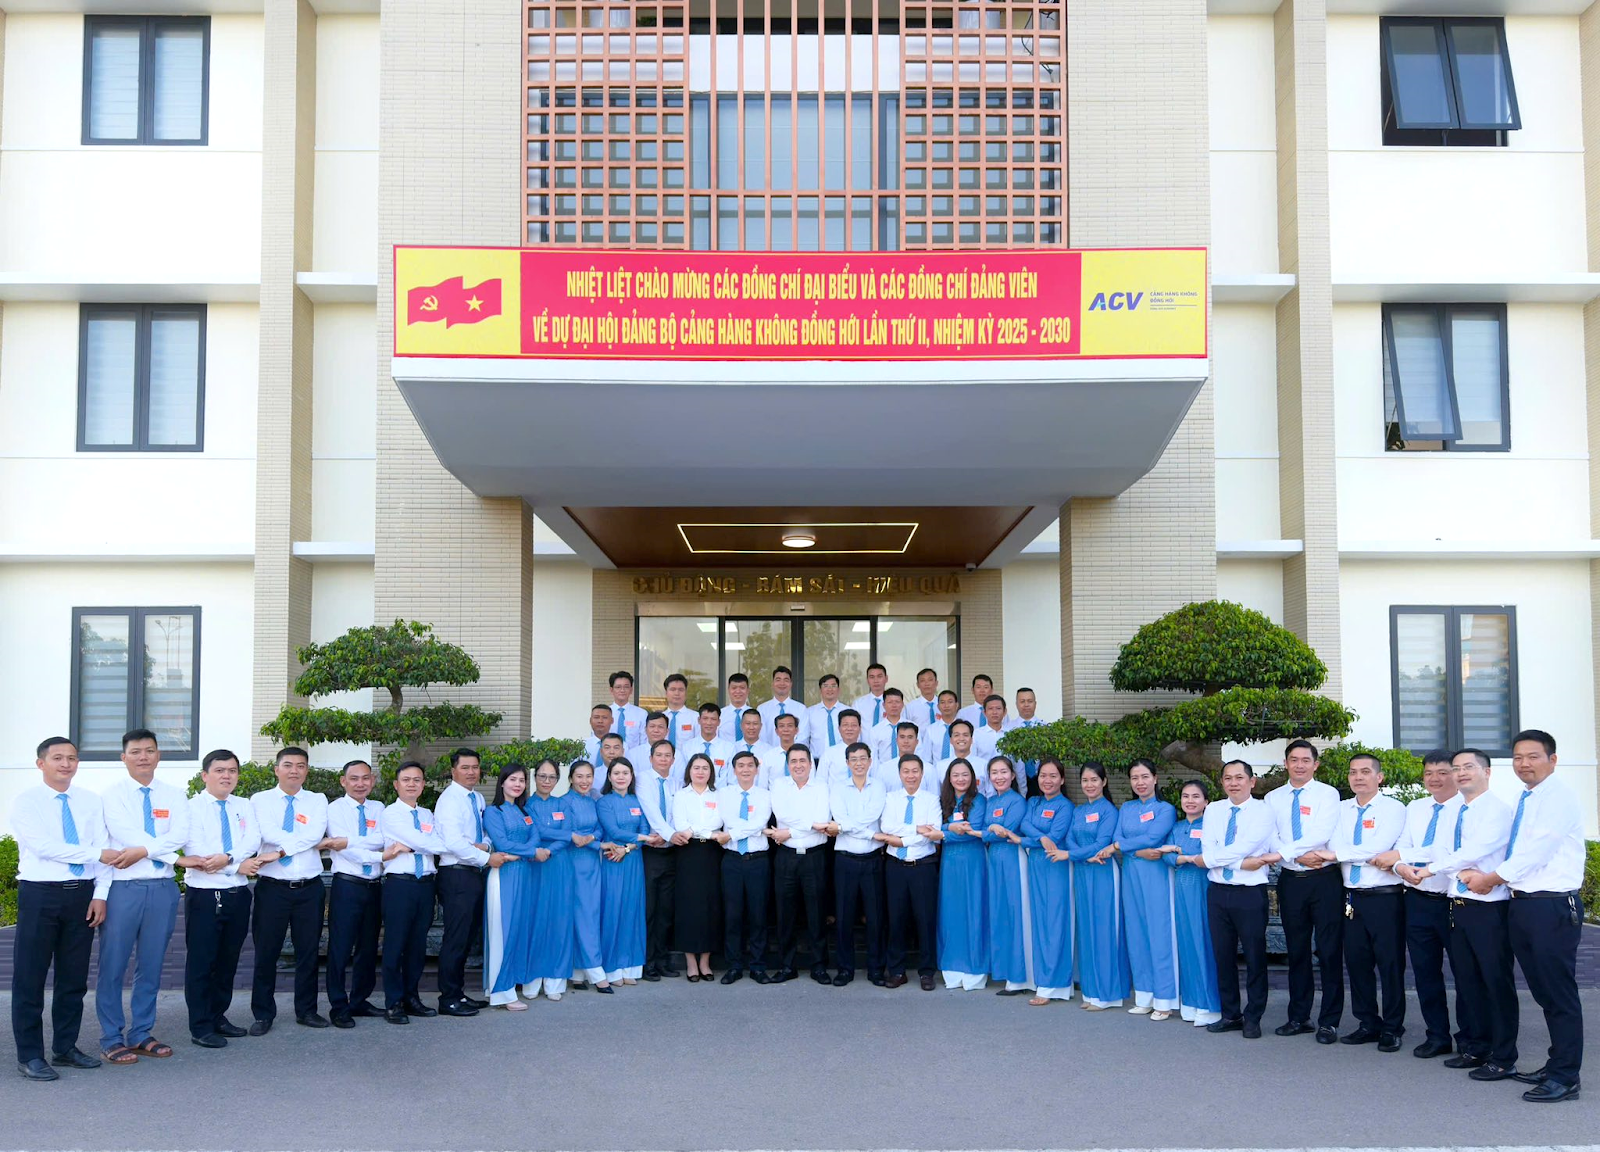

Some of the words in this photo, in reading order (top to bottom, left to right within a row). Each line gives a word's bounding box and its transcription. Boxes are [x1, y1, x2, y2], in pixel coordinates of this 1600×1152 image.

[566, 265, 603, 304] NHIỆT
[606, 266, 633, 304] LIỆT
[635, 266, 669, 299] CHÀO
[672, 266, 711, 299] MỪNG
[713, 267, 739, 300] CÁC
[741, 264, 777, 300] ĐỒNG
[780, 267, 801, 300] CHÍ
[803, 273, 826, 306] ĐẠI
[828, 262, 858, 300] BIỂU
[860, 267, 877, 300] VÀ
[880, 267, 906, 300] CÁC
[907, 264, 943, 300] ĐỒNG
[946, 267, 968, 300] CHÍ
[970, 263, 1006, 299] ĐẢNG
[1008, 266, 1038, 299] VIÊN
[1088, 292, 1144, 311] ACV
[532, 307, 549, 343] VỀ
[551, 313, 571, 349] DỰ
[572, 316, 594, 350] ĐẠI
[596, 311, 619, 350] HỘI
[621, 308, 657, 345] ĐẢNG
[659, 311, 677, 351] BỘ
[679, 308, 715, 345] CẢNG
[717, 312, 753, 345] HÀNG
[755, 313, 799, 346] KHÔNG
[800, 309, 836, 346] ĐỒNG
[838, 313, 860, 346] HỚI
[863, 309, 888, 346] LẦN
[890, 312, 917, 346] THỨ
[917, 318, 931, 349] II,
[933, 312, 975, 351] NHIỆM
[977, 312, 995, 345] KỲ
[996, 317, 1029, 345] 2025
[1039, 316, 1071, 344] 2030
